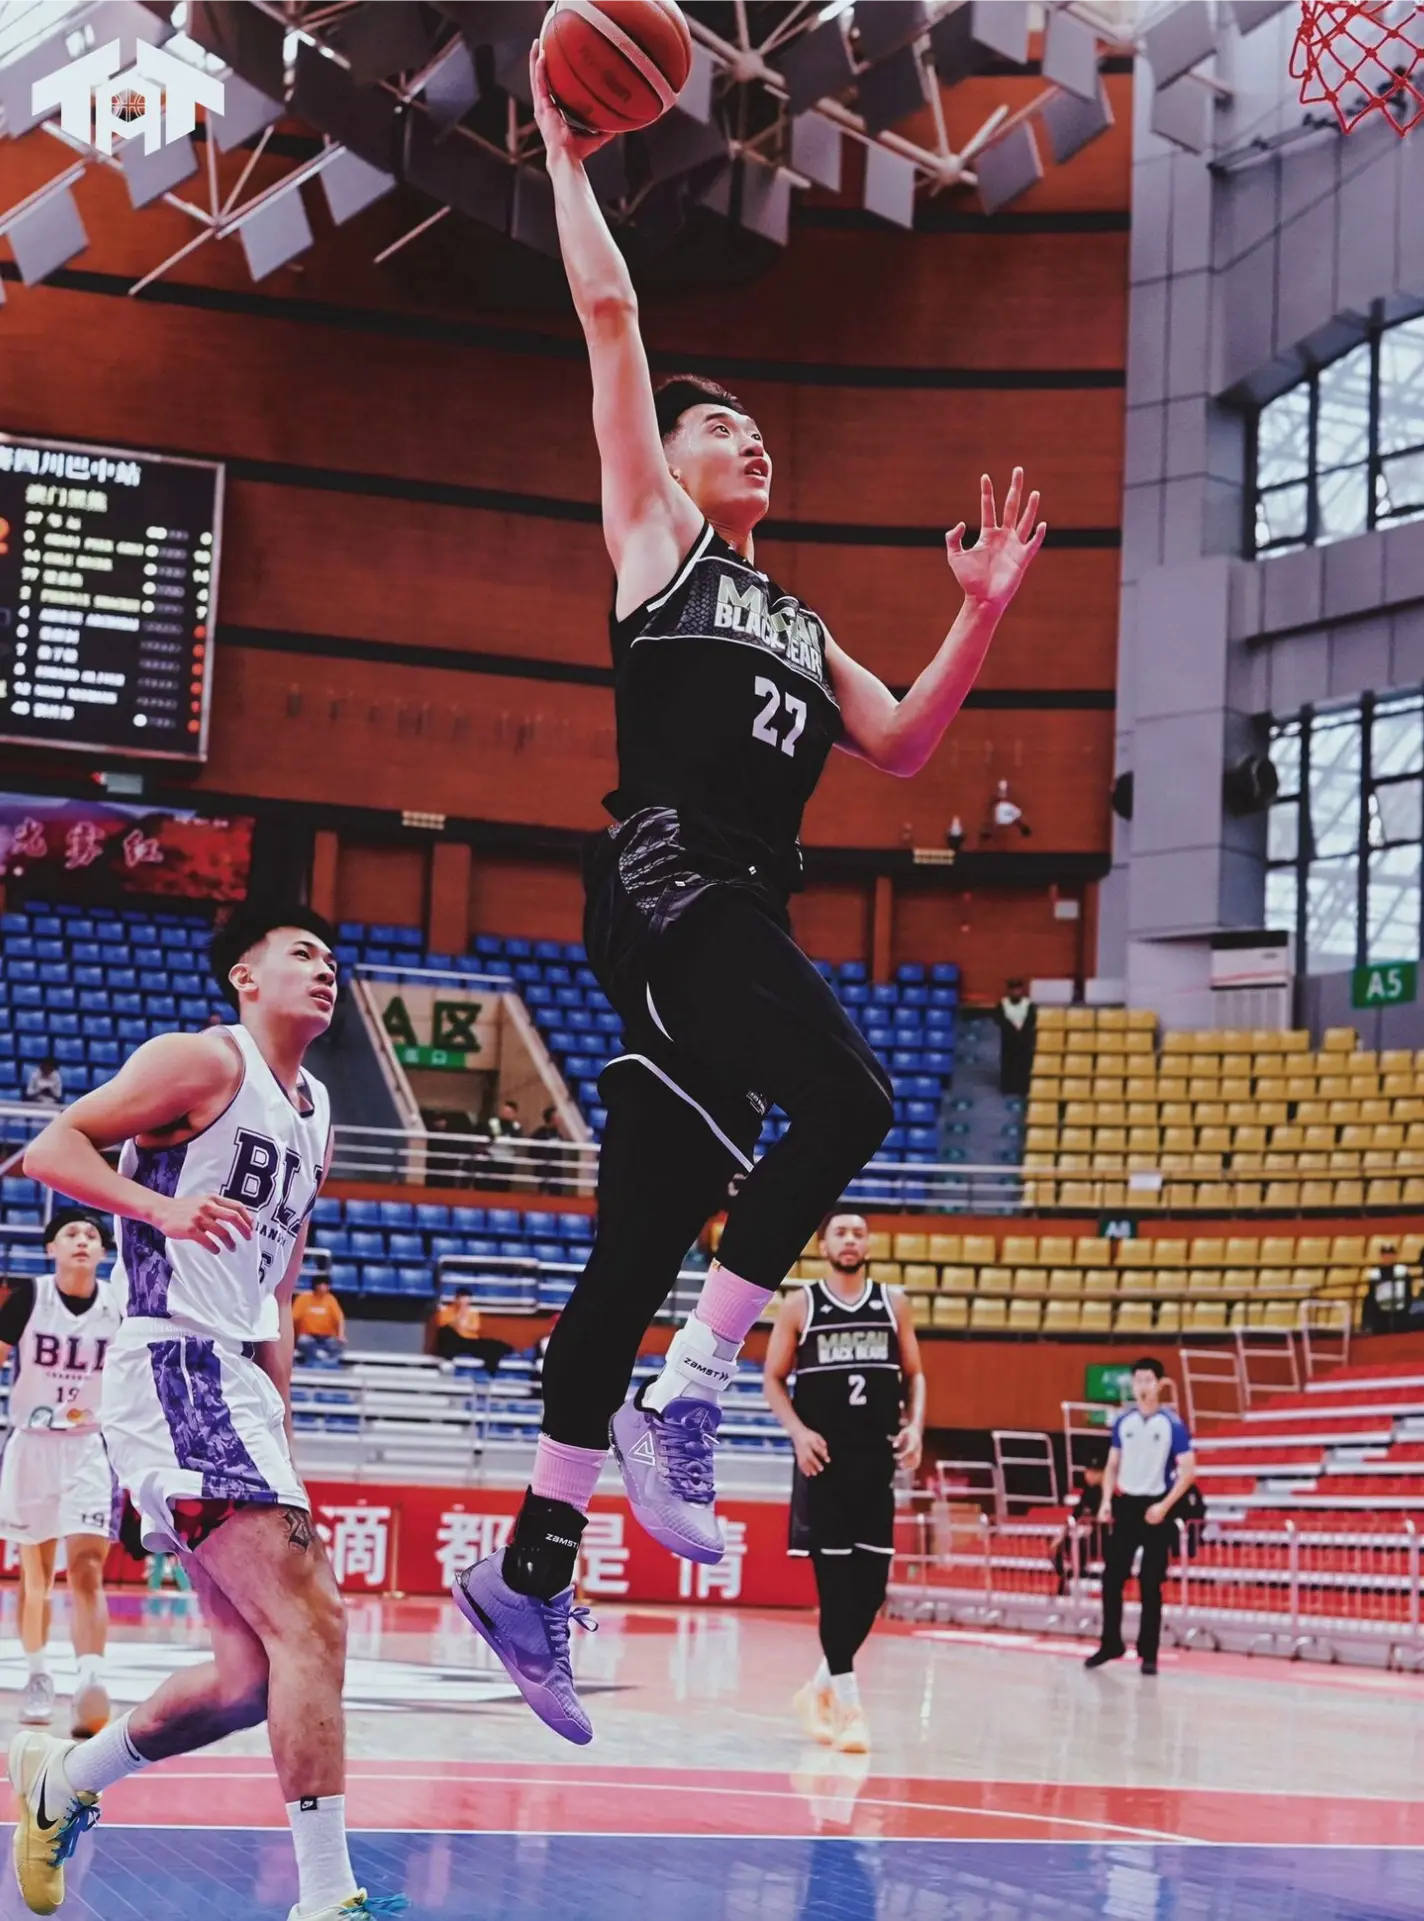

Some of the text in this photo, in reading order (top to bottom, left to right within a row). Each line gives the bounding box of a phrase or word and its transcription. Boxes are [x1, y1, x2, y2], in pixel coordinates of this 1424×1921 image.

[752, 675, 808, 758] 27
[1366, 969, 1402, 999] A5
[848, 1374, 867, 1405] 2
